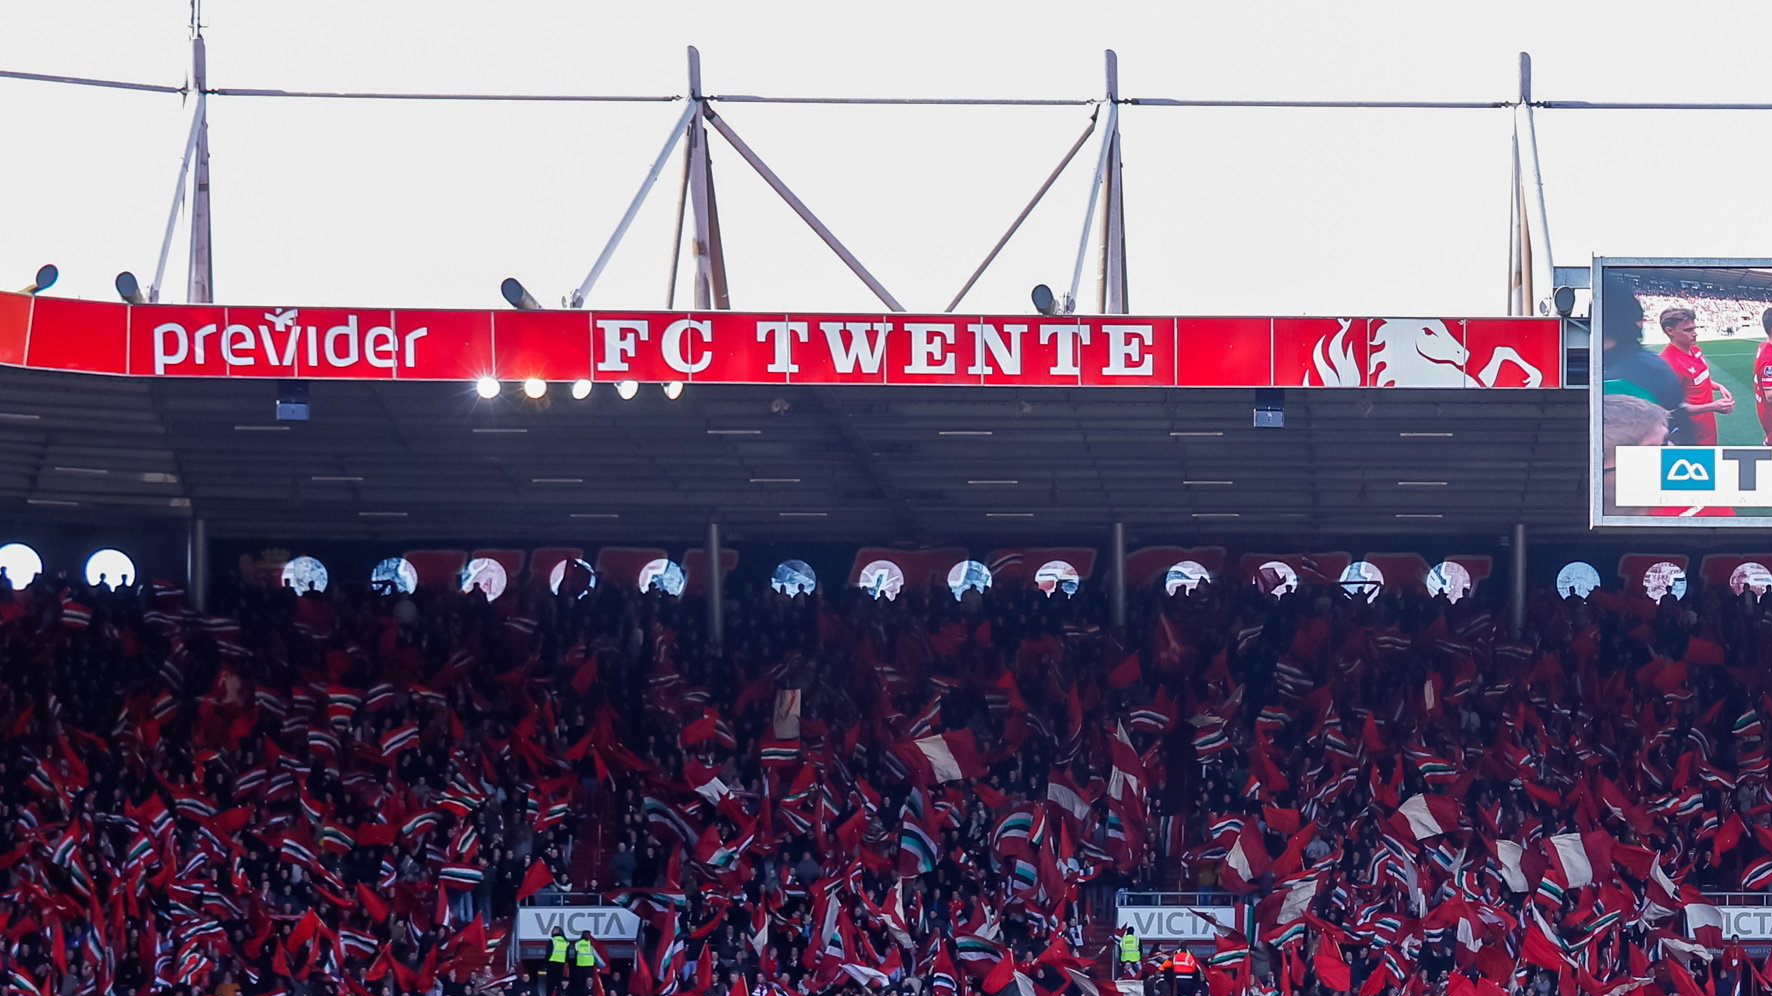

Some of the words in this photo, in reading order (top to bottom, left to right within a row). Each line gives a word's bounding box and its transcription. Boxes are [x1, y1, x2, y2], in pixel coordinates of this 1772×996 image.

[153, 309, 428, 375] previder
[596, 319, 713, 373] FC
[757, 321, 1155, 376] TWENTE
[535, 912, 626, 936] VICTA
